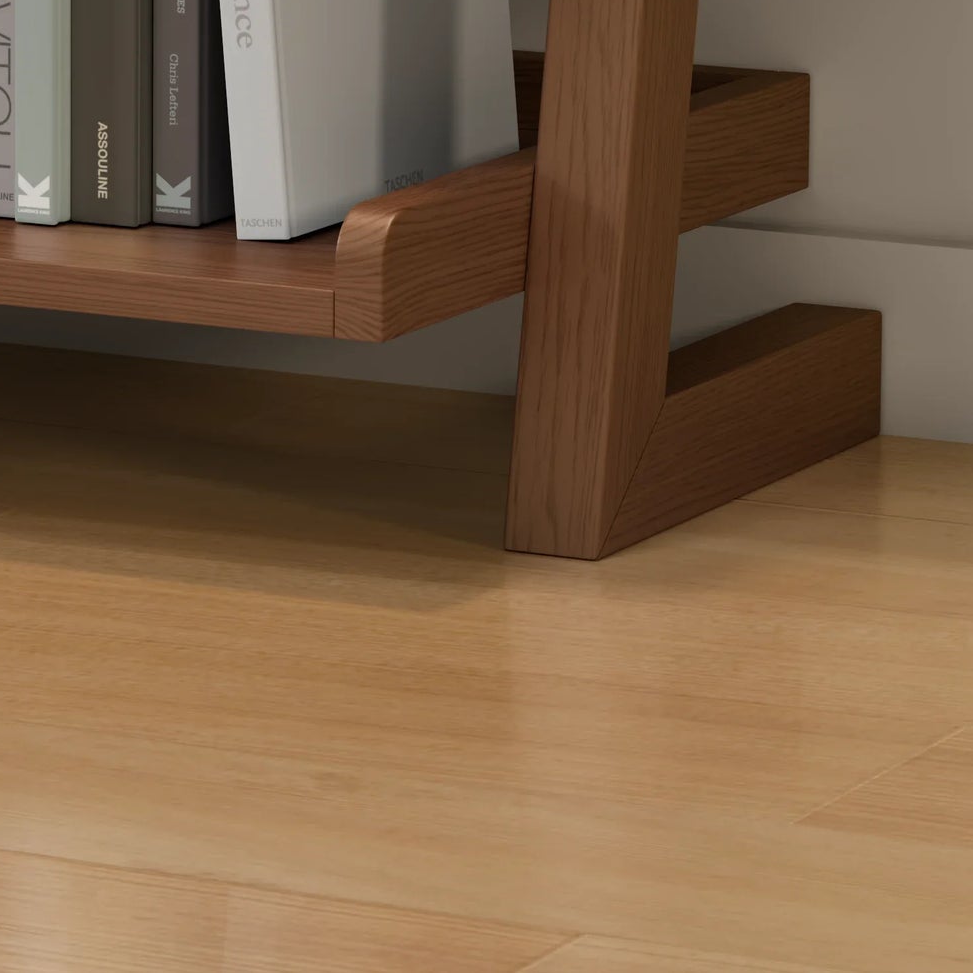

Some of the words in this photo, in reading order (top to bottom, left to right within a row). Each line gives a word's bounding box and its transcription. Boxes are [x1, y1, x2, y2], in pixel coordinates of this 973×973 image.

[169, 54, 178, 83] Chris
[169, 86, 178, 125] Lefteri
[97, 121, 108, 200] ASSOULINE
[240, 218, 283, 227] TASCHEN
